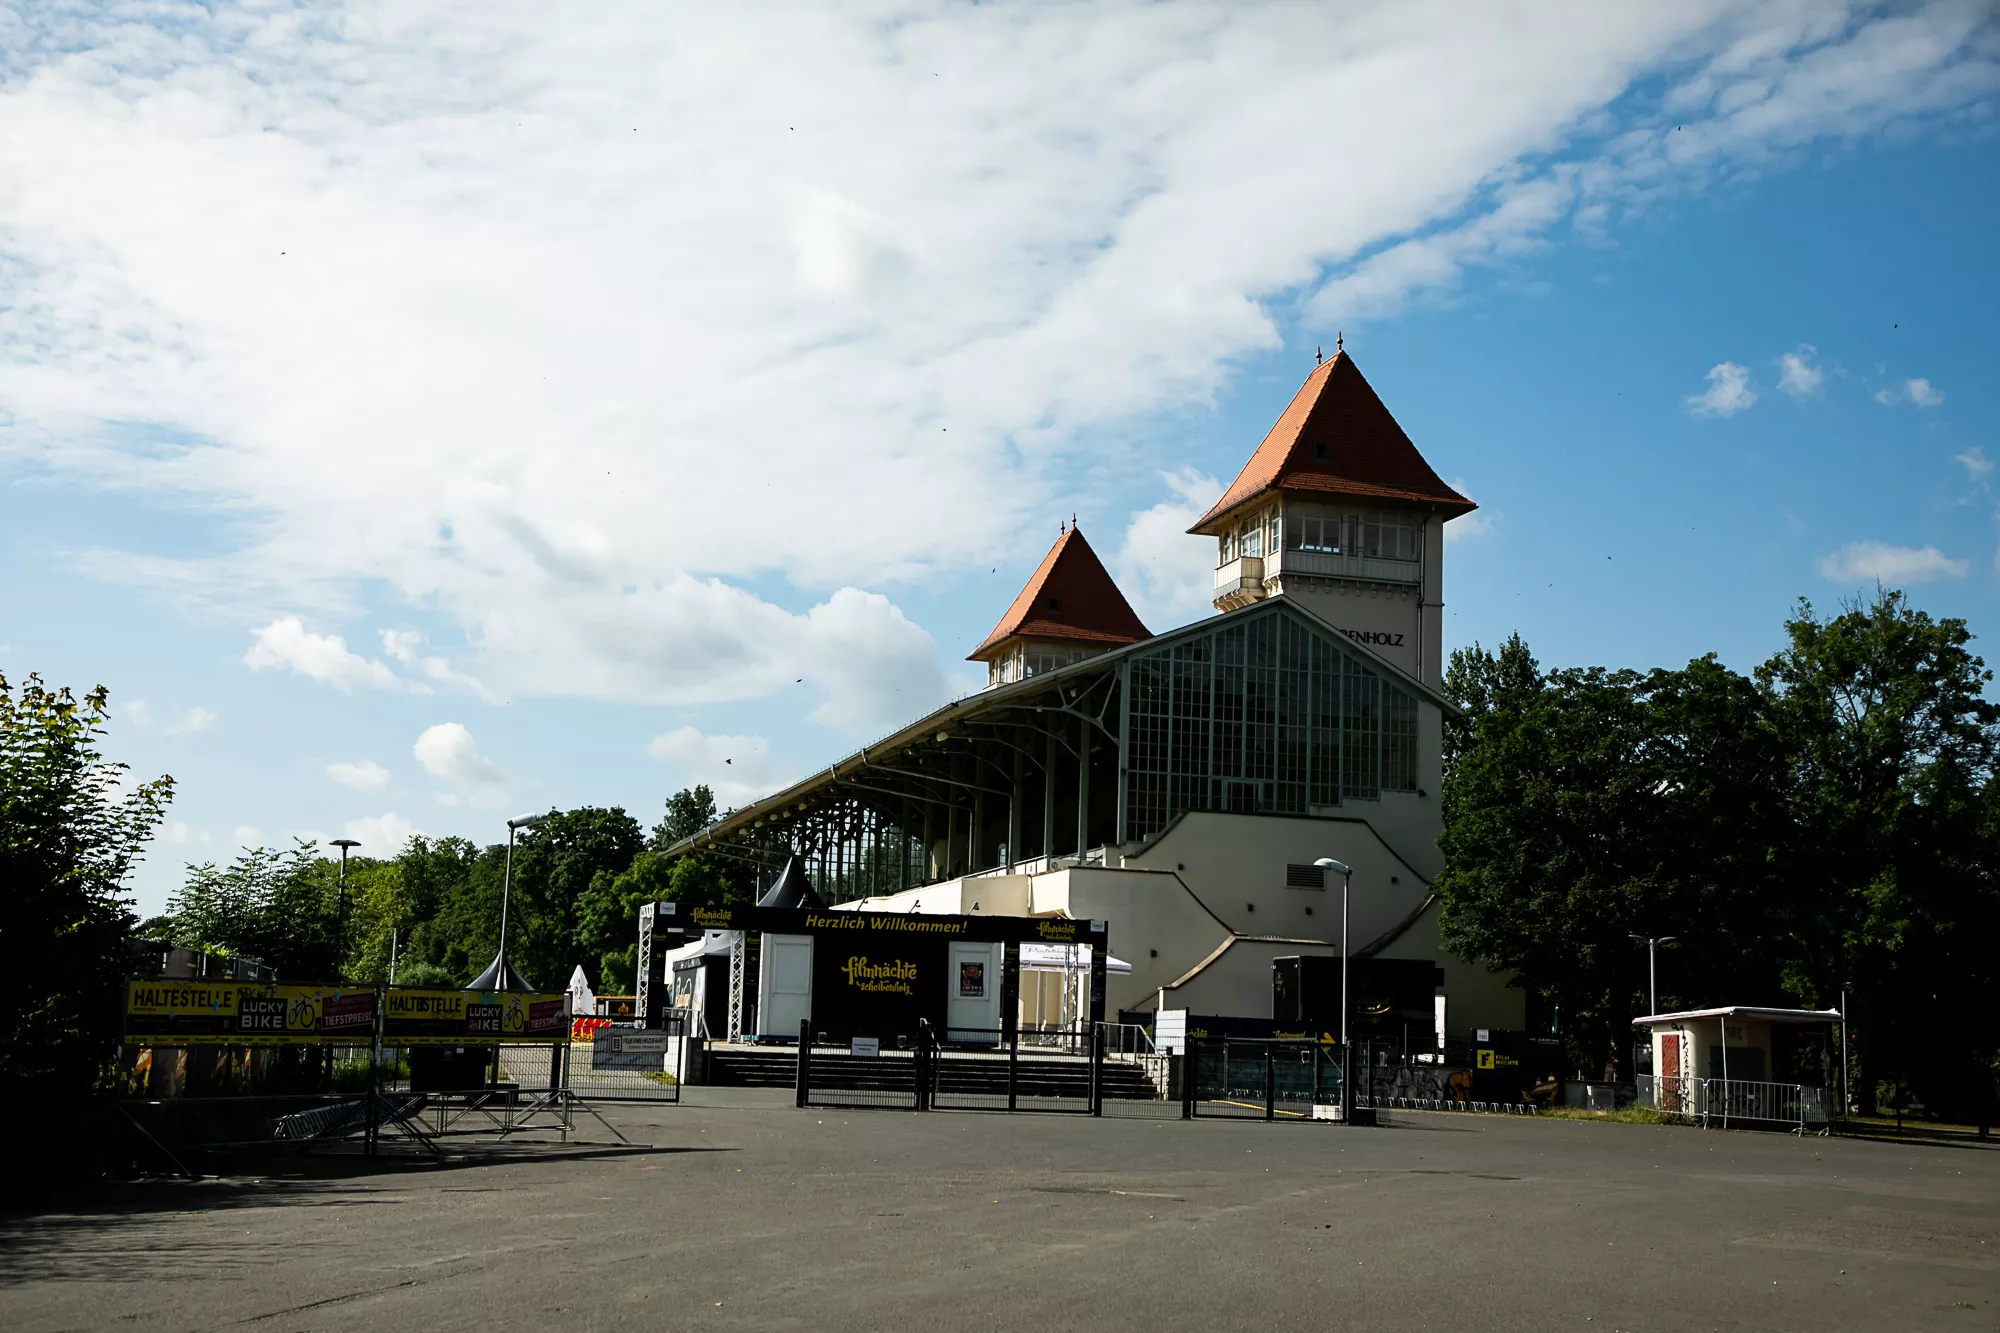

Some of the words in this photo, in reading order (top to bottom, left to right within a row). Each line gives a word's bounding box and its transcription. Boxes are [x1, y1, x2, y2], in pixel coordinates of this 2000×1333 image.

[805, 913, 865, 930] Herzlich
[870, 916, 968, 934] Willkommen!
[840, 955, 918, 986] filmnächte
[133, 987, 232, 1008] HALTESTELLE
[242, 1001, 285, 1013] LUCKY
[469, 1006, 501, 1017] LUCKY
[241, 1014, 283, 1029] BIKE
[473, 1018, 500, 1031] IKE
